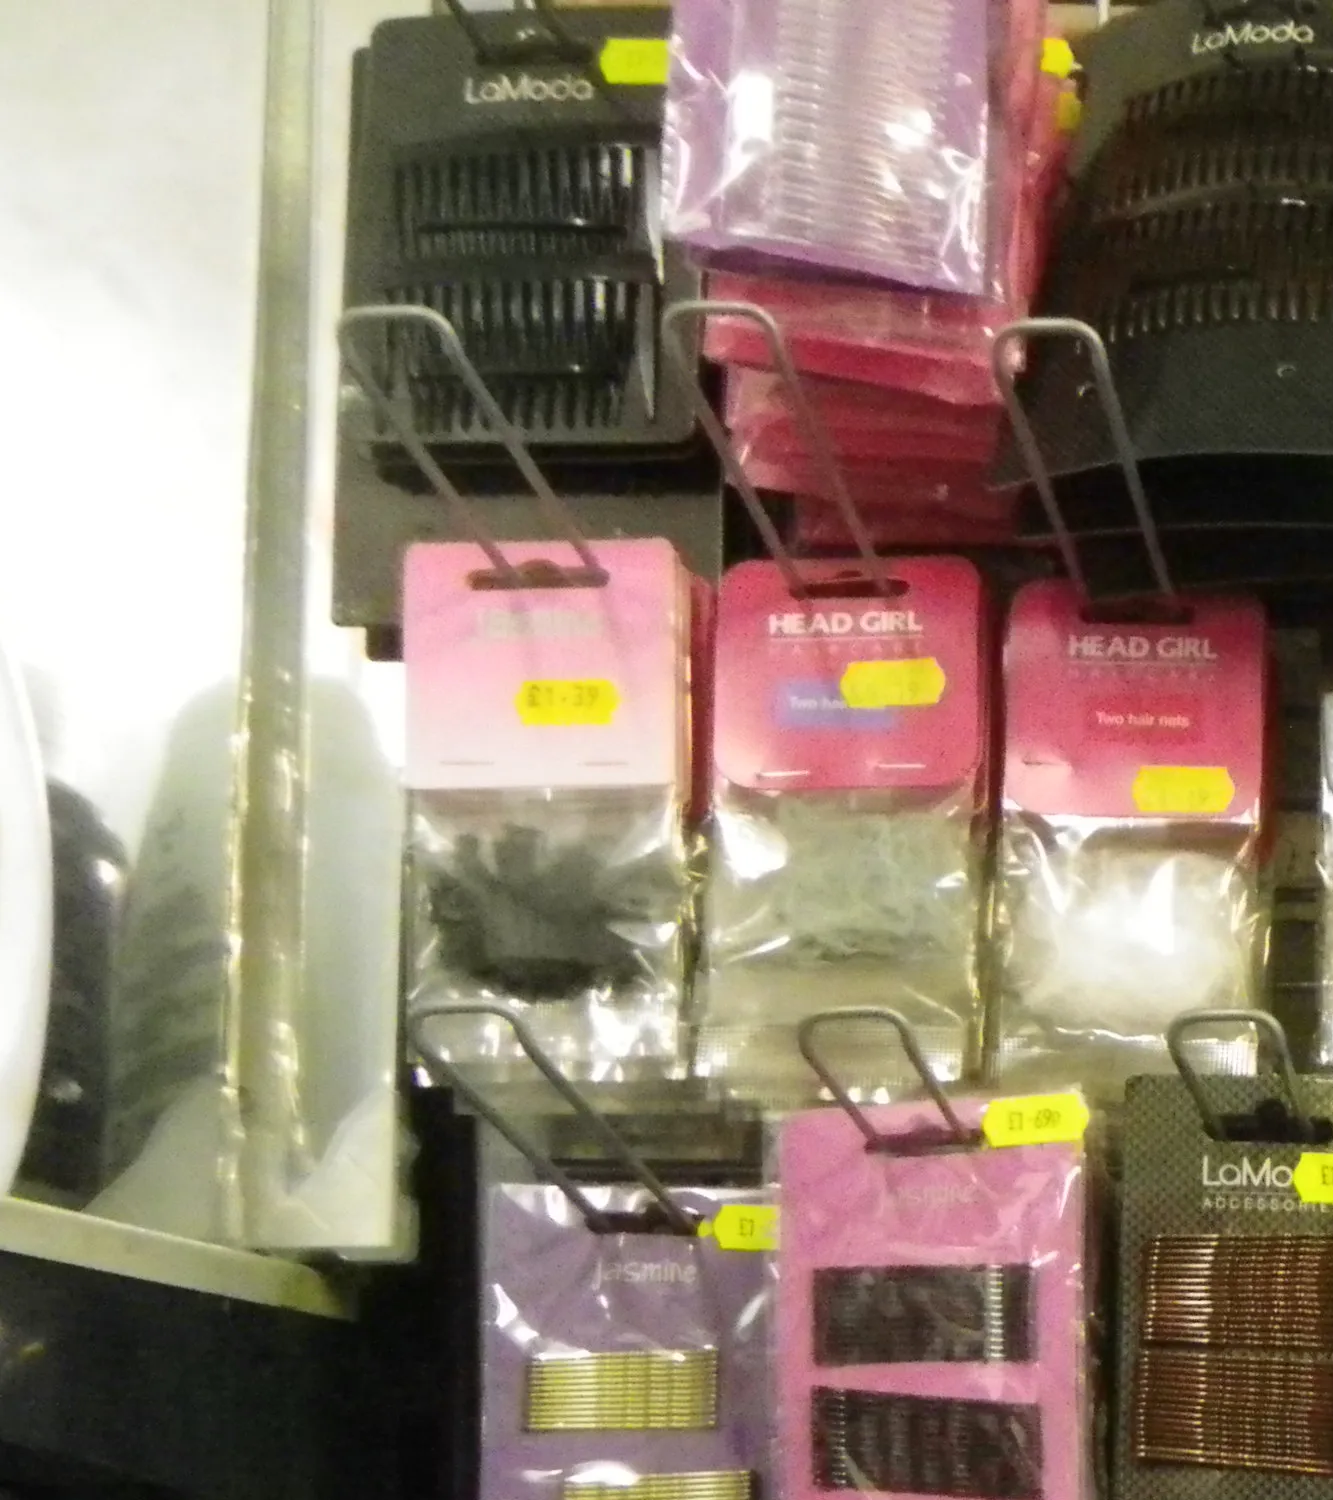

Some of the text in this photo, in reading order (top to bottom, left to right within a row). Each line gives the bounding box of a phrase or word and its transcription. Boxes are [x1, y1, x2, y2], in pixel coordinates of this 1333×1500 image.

[1192, 18, 1315, 54] LaModa
[464, 73, 594, 104] LaModa
[768, 610, 924, 635] HEAD GIRL
[1067, 634, 1218, 659] HEAD GIRL
[1095, 710, 1191, 728] Two hair nets
[1202, 1155, 1297, 1189] LaMo
